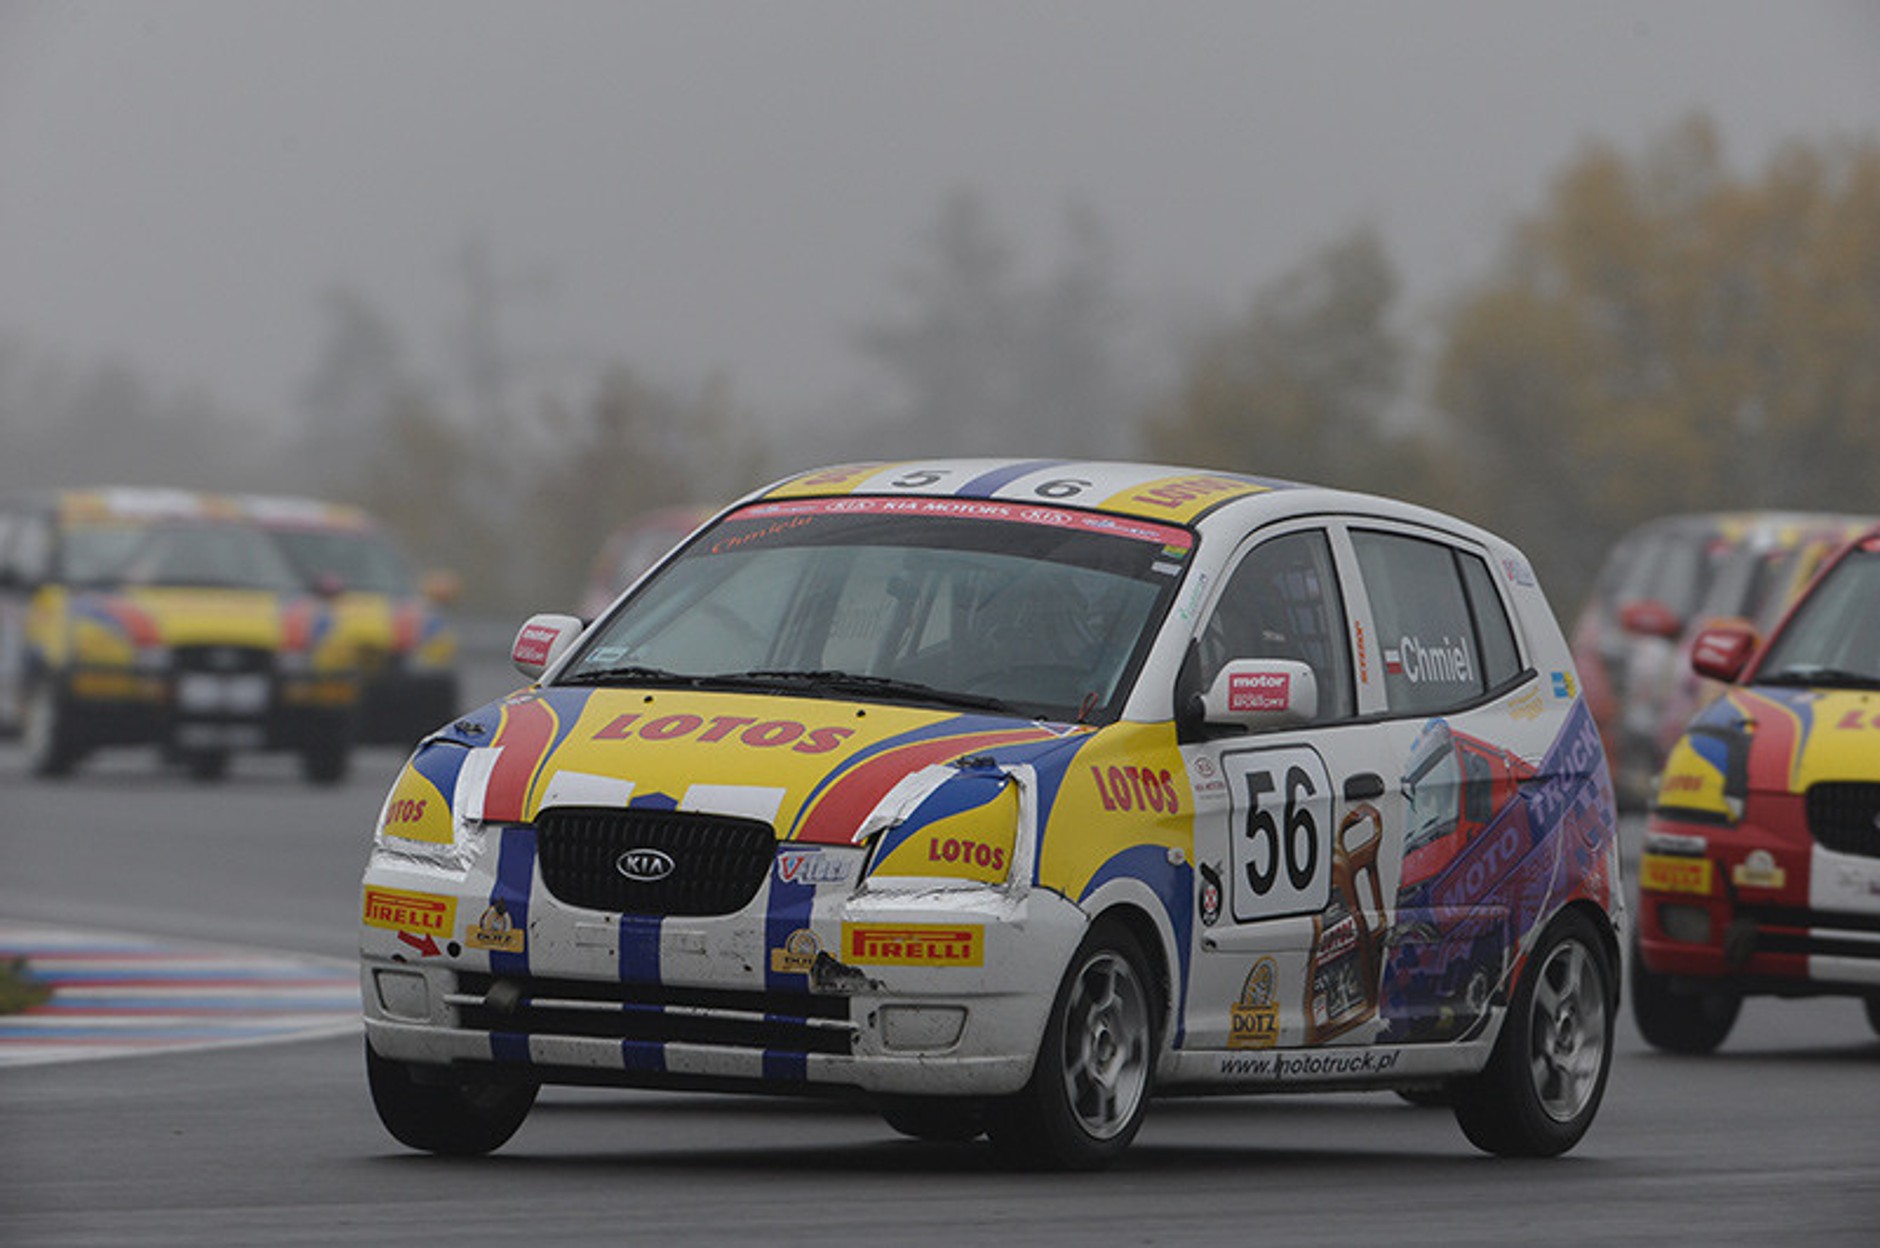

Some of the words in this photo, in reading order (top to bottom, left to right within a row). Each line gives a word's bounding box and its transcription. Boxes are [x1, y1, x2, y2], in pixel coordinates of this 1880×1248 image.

[891, 470, 951, 488] 5
[1034, 479, 1093, 499] 6
[883, 500, 917, 511] KIA
[922, 502, 1010, 516] MOTORS
[1400, 636, 1474, 683] Chmiel
[1233, 675, 1287, 688] motor
[592, 714, 855, 754] LOTOS
[1091, 765, 1179, 815] LOTOS
[1244, 765, 1318, 896] 56
[1442, 827, 1520, 918] MOTO
[1531, 721, 1599, 826] TRUCK
[626, 856, 666, 874] KIA
[928, 837, 1005, 871] LOTOS
[366, 891, 447, 930] PIRELLI
[853, 929, 973, 959] PIRELLI
[1232, 1014, 1276, 1033] DOTZ
